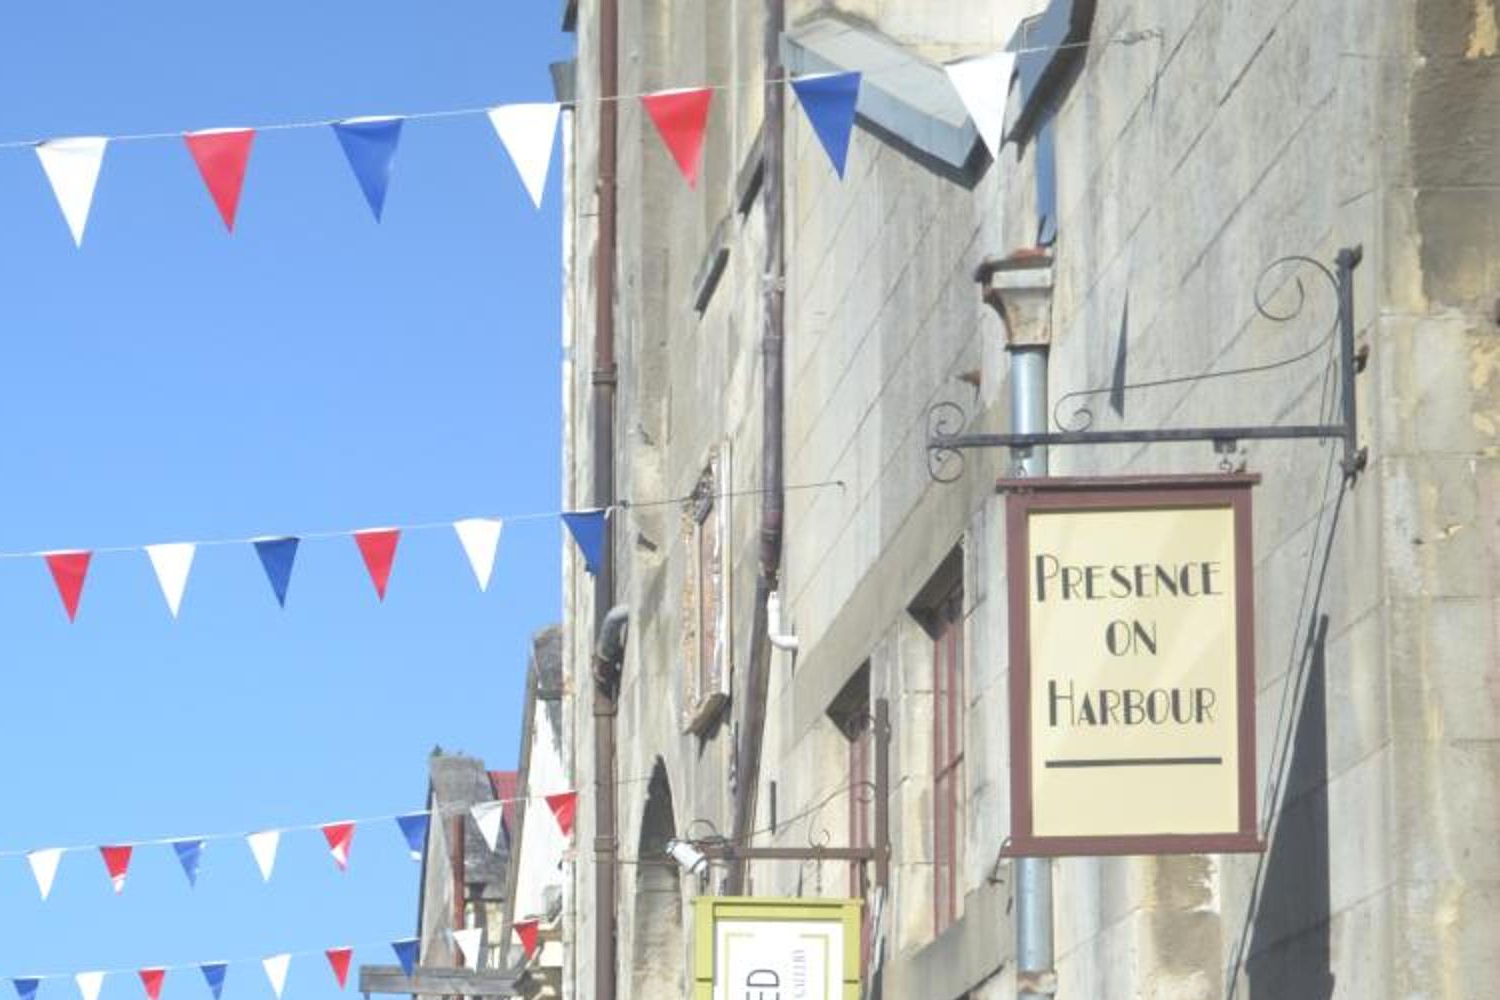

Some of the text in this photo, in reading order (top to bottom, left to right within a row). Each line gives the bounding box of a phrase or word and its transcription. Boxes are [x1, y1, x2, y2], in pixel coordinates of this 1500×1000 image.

[1035, 554, 1223, 602] PRESENCE
[1105, 620, 1158, 656] ON
[1047, 679, 1217, 727] HARBOUR
